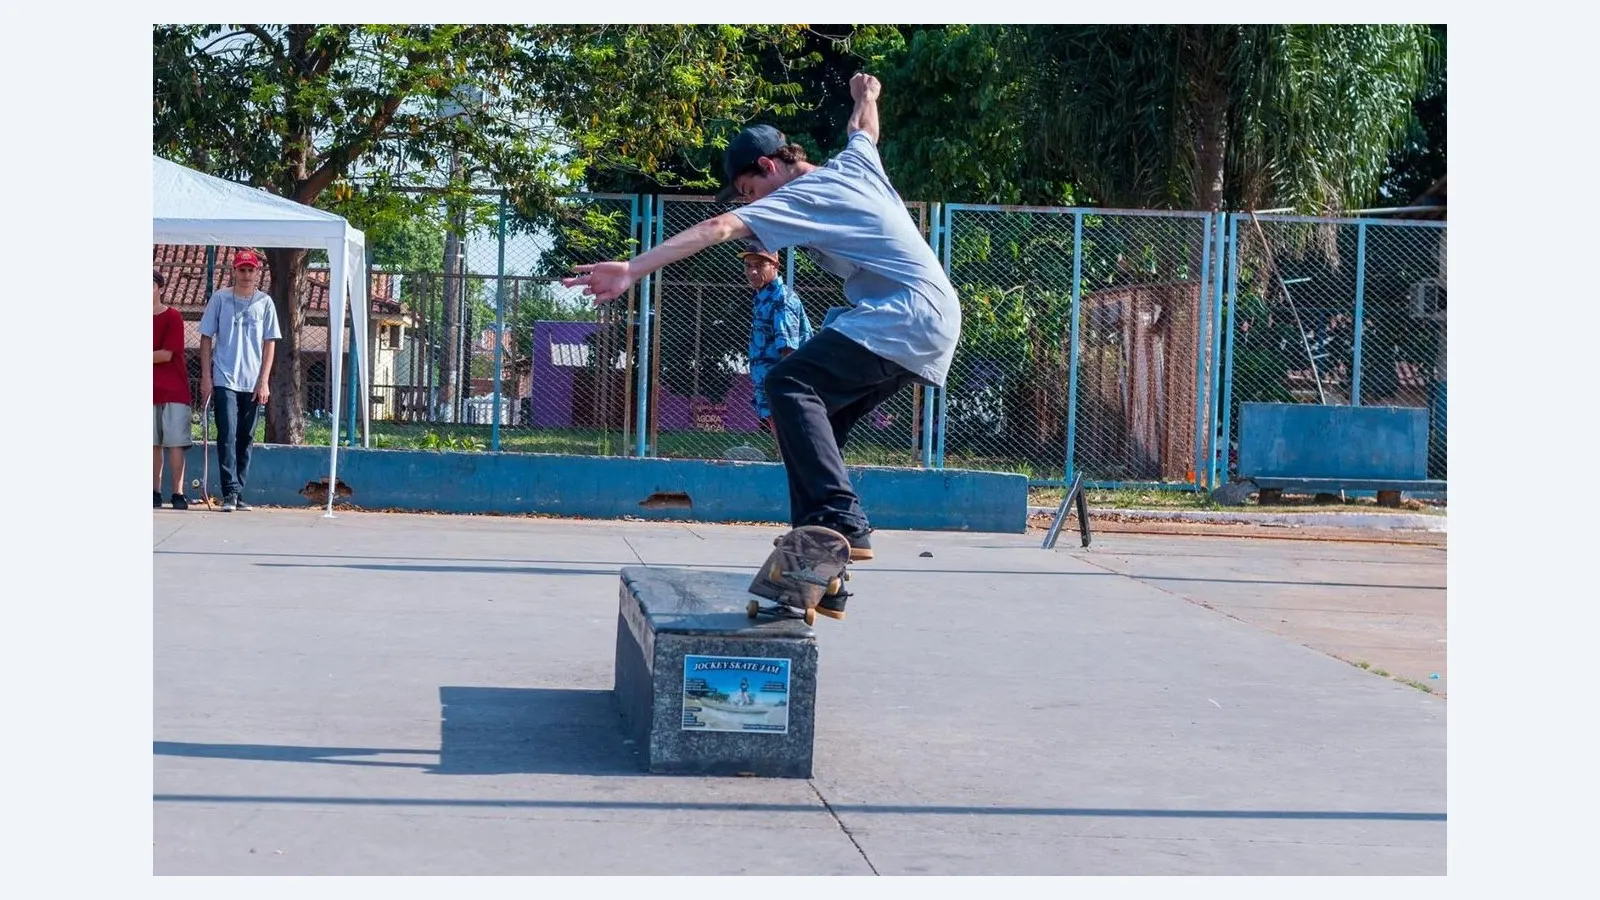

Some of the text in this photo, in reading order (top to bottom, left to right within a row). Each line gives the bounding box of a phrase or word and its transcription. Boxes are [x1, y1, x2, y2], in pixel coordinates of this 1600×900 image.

[696, 415, 721, 423] AGORA
[694, 661, 780, 674] JOCKEY SKATE JAM
